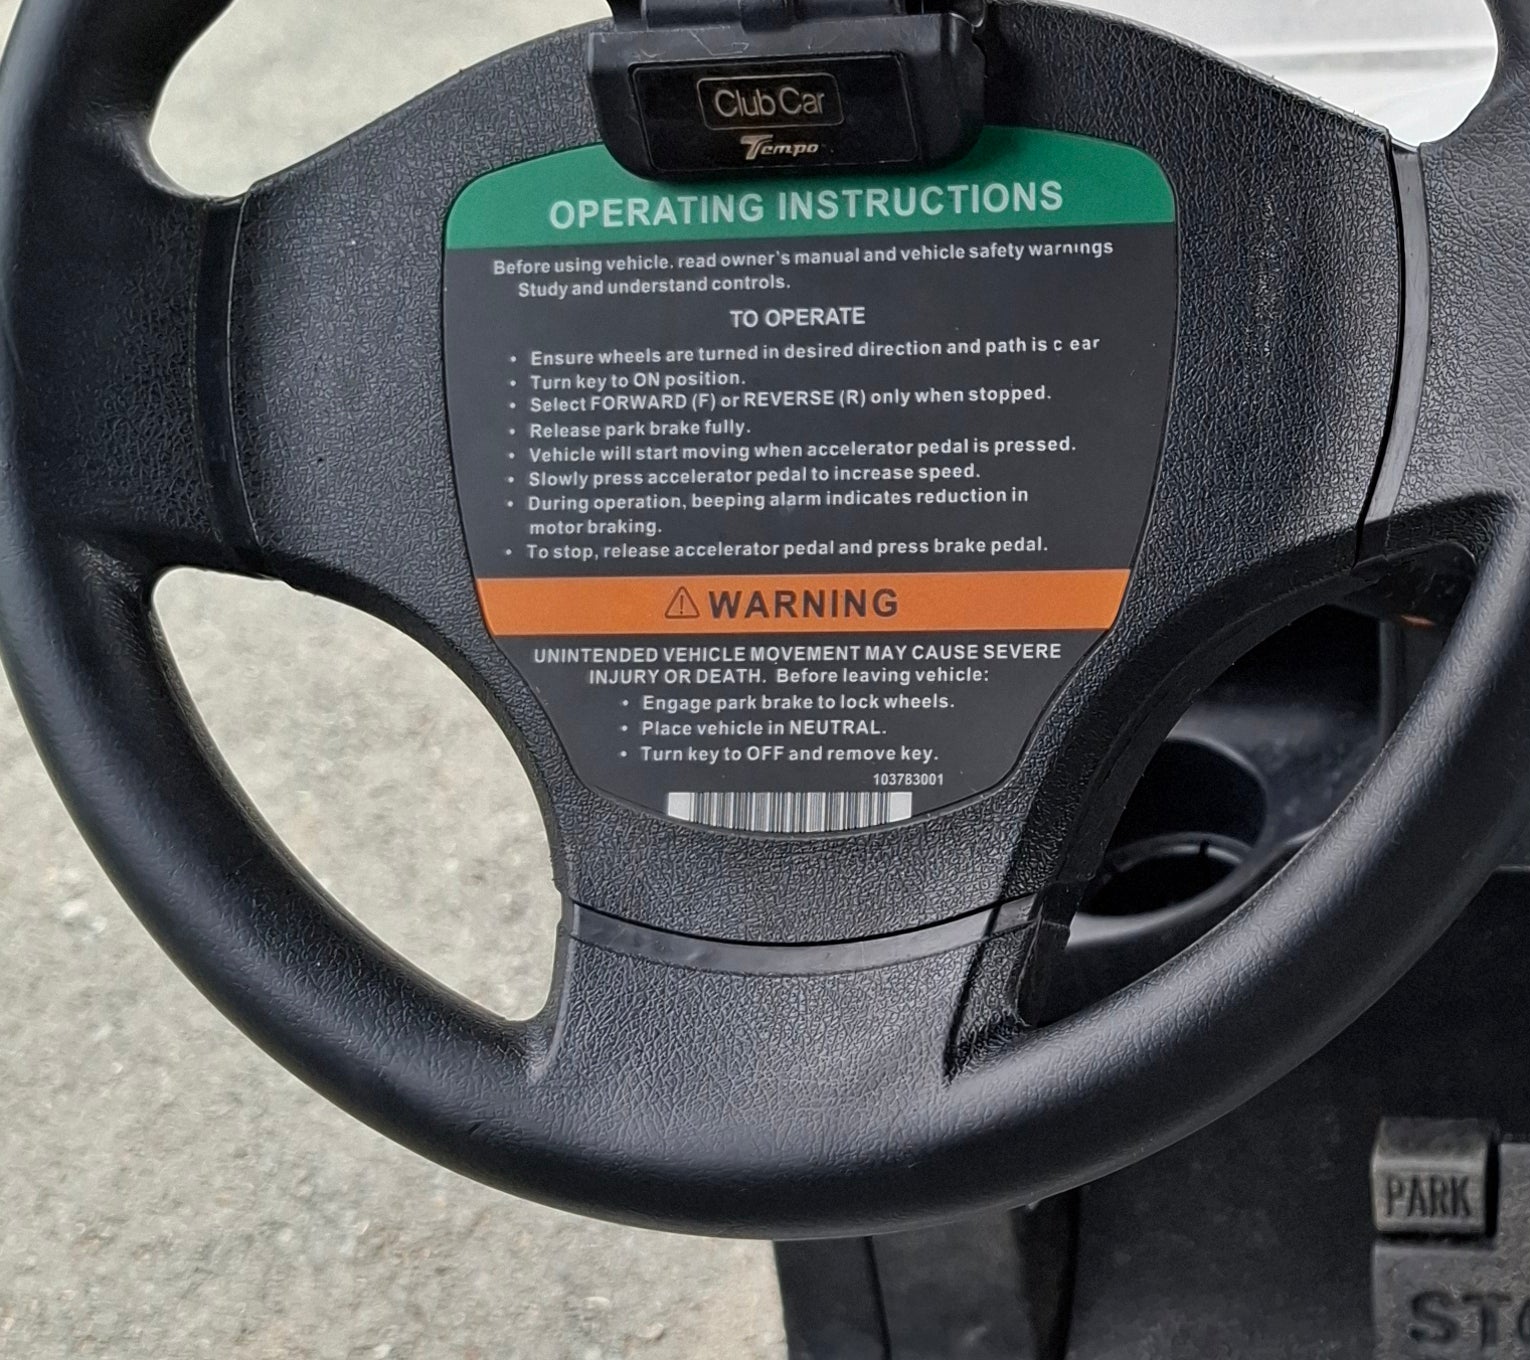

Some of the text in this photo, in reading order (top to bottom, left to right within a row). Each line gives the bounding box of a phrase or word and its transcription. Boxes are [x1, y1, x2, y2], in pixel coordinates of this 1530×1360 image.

[714, 86, 826, 118] Club Car
[740, 134, 819, 160] Tempo
[549, 180, 1063, 230] OPERATING INSTRUCTIONS
[492, 258, 551, 276] Before
[553, 256, 603, 276] using
[677, 252, 717, 269] read
[718, 249, 791, 268] owner's
[793, 246, 860, 265] manual
[862, 245, 897, 263] and
[899, 243, 966, 262] vehicle
[968, 241, 1025, 262] safety
[517, 273, 791, 301] Study and understand controls.
[728, 305, 866, 329] TO OPERATE
[530, 350, 595, 367] Ensure
[596, 347, 662, 365] wheels
[664, 349, 695, 363] are
[696, 344, 759, 362] turned
[762, 344, 780, 360] in
[781, 341, 854, 360] desired
[856, 339, 943, 358] direction
[945, 337, 981, 355] and
[984, 336, 1027, 358] path
[1031, 336, 1048, 353] is
[529, 369, 746, 393] Turn key to ON position.
[529, 386, 1052, 413] Select FORWARD (F) or REVERSE (R) only when stopped.
[529, 418, 751, 441] Release park brake fully.
[528, 435, 1077, 463] Vehicle will start moving when accelerator pedal is pressed.
[528, 462, 981, 490] Slowly press accelerator pedal to increase speed.
[527, 486, 1029, 514] During operation, beeping alarm indicates reduction in
[528, 518, 663, 538] motor braking.
[525, 535, 1050, 562] To stop, release accelerator pedal and press brake pedal.
[708, 588, 898, 620] WARNING
[533, 642, 1062, 665] UNINTENDED VEHICLE MOVEMENT MAY CAUSE SEVERE
[588, 666, 989, 687] INJURY OR DEATH. Before leaving vehicle:
[641, 692, 955, 714] Engage park brake to lock wheels.
[640, 719, 887, 737] Place vehicle in NEUTRAL.
[639, 744, 939, 766] Turn key to OFF and remove key.
[872, 772, 944, 786] 103783001
[1386, 1174, 1473, 1220] PARK
